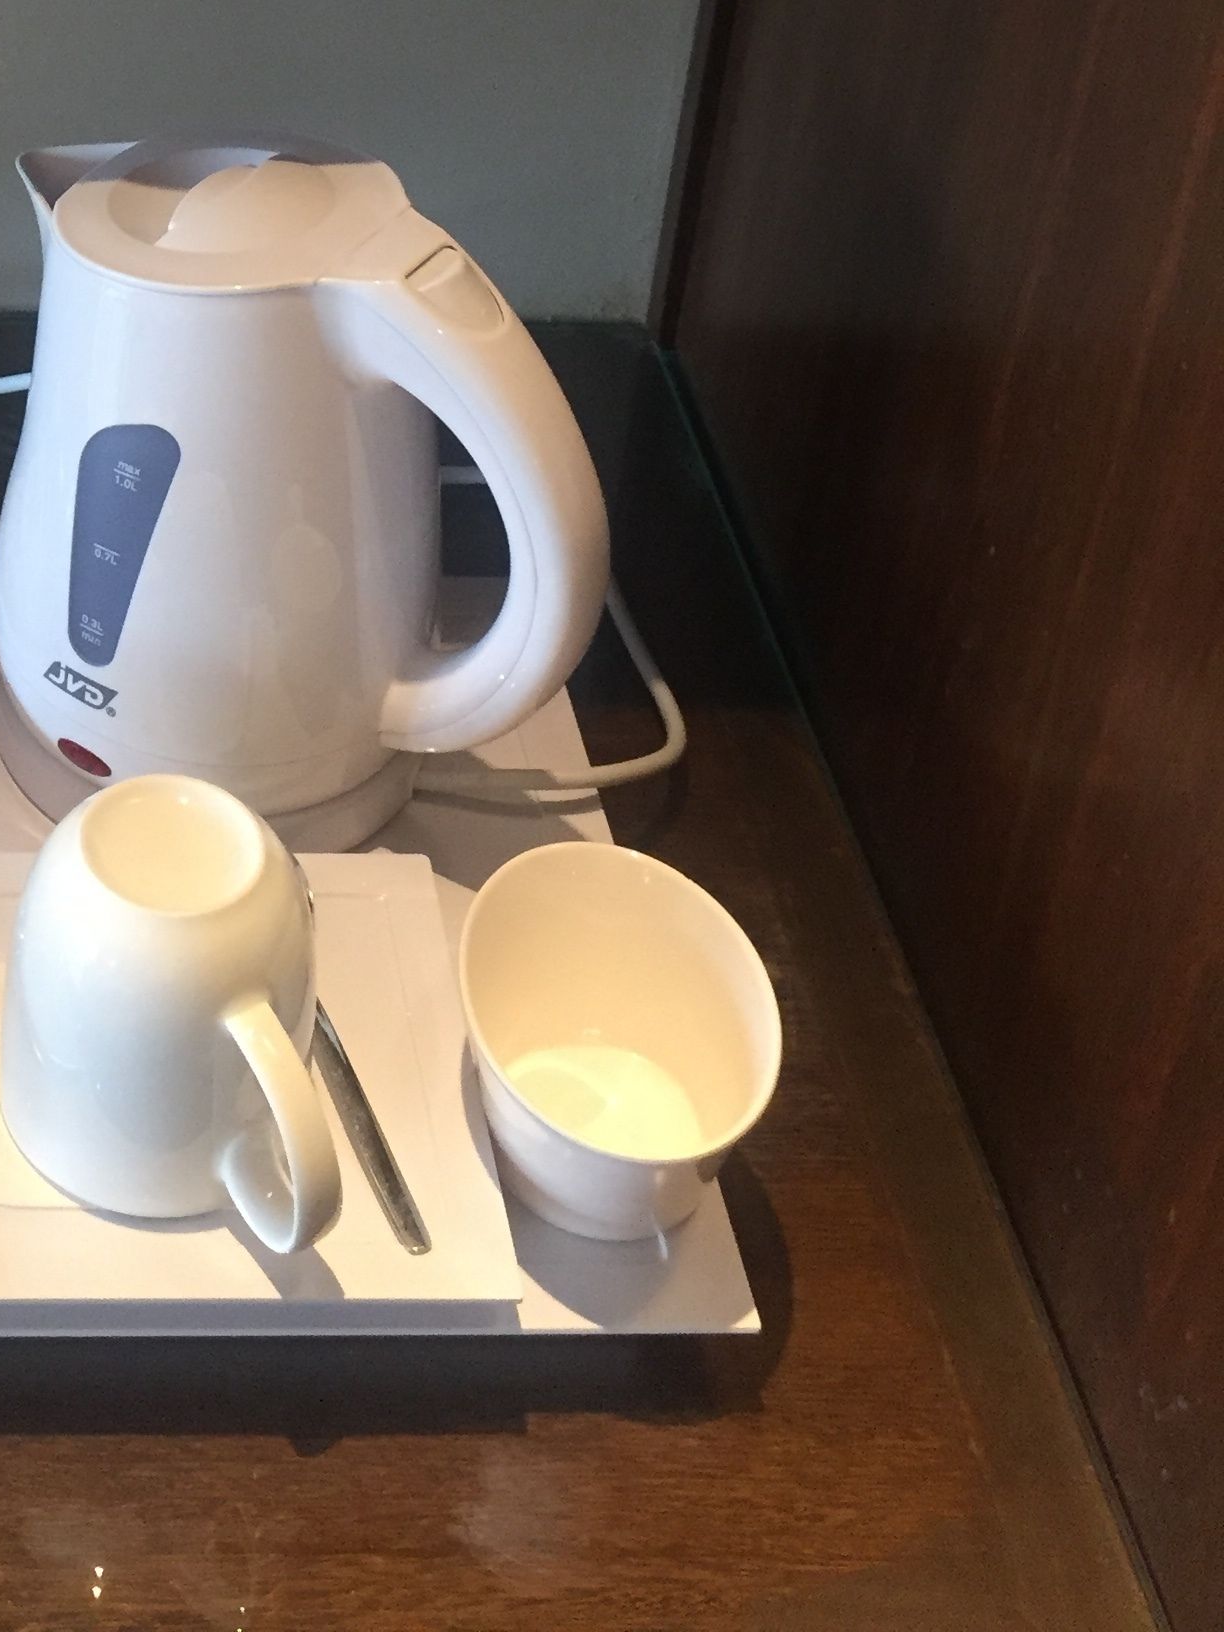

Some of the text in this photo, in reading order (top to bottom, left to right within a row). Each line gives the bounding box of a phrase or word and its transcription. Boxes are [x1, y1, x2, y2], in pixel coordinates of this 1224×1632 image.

[117, 460, 141, 476] max
[115, 475, 138, 492] 1.0L
[94, 548, 117, 566] 0.7L
[81, 614, 104, 632] 0.3L
[81, 630, 102, 647] min
